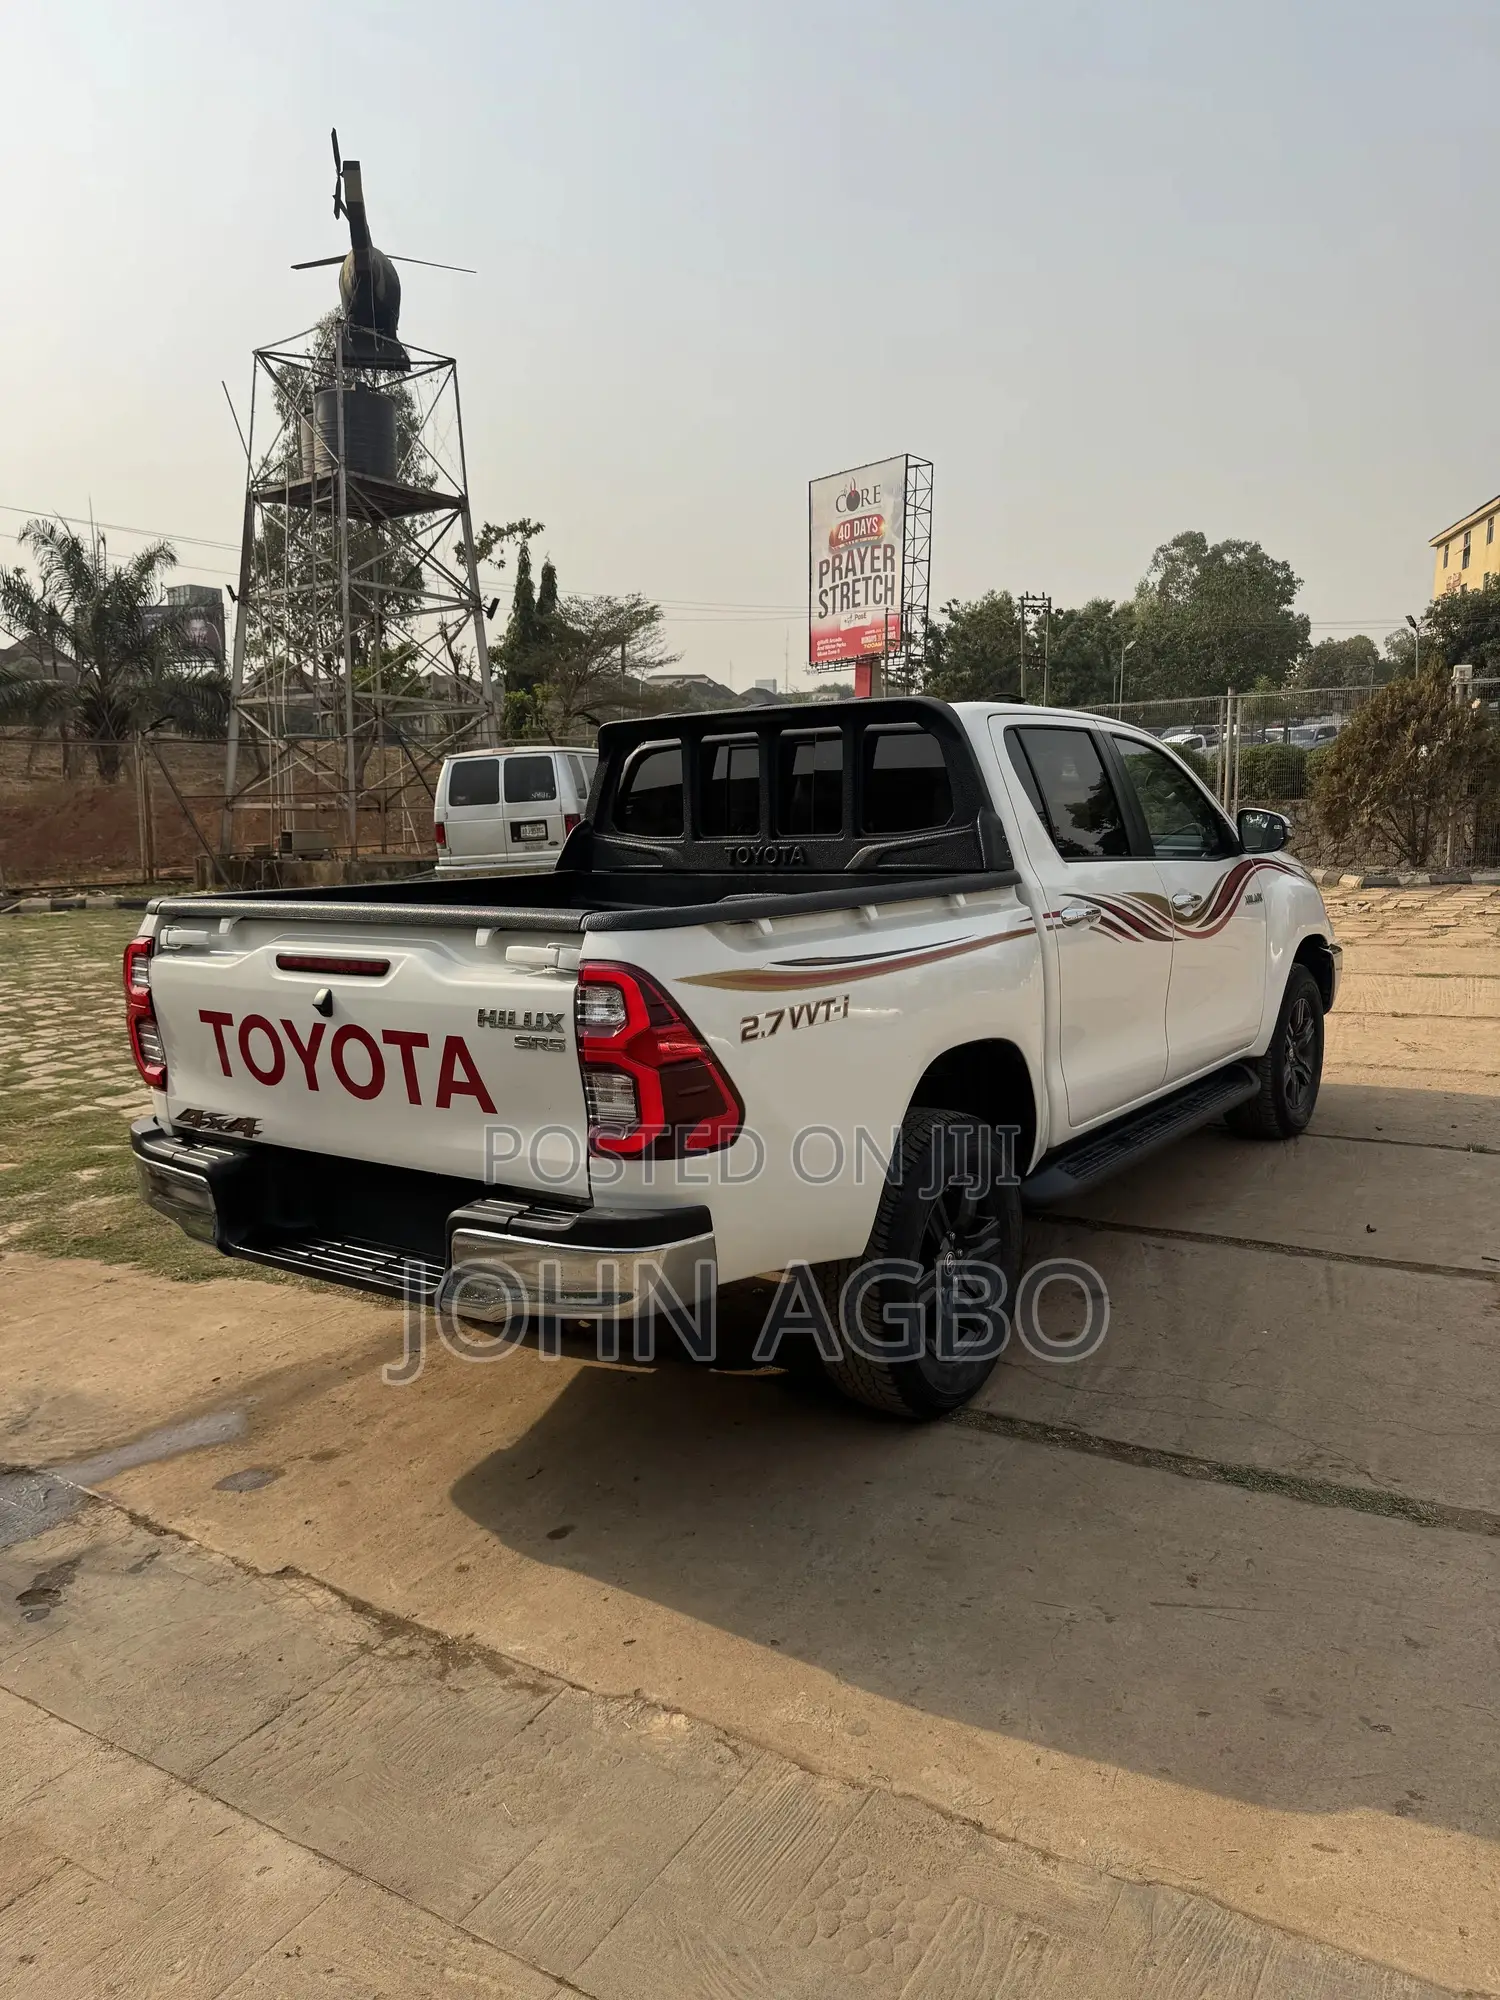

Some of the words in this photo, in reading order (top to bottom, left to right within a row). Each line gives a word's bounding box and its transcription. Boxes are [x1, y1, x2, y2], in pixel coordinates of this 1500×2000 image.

[838, 523, 851, 541] 40
[854, 516, 879, 537] DAYS
[818, 544, 896, 588] PRAYER
[818, 572, 896, 619] STRETCH
[724, 846, 805, 864] TOYOTA
[477, 1007, 565, 1033] HILUX
[198, 1009, 498, 1114] TOYOTA
